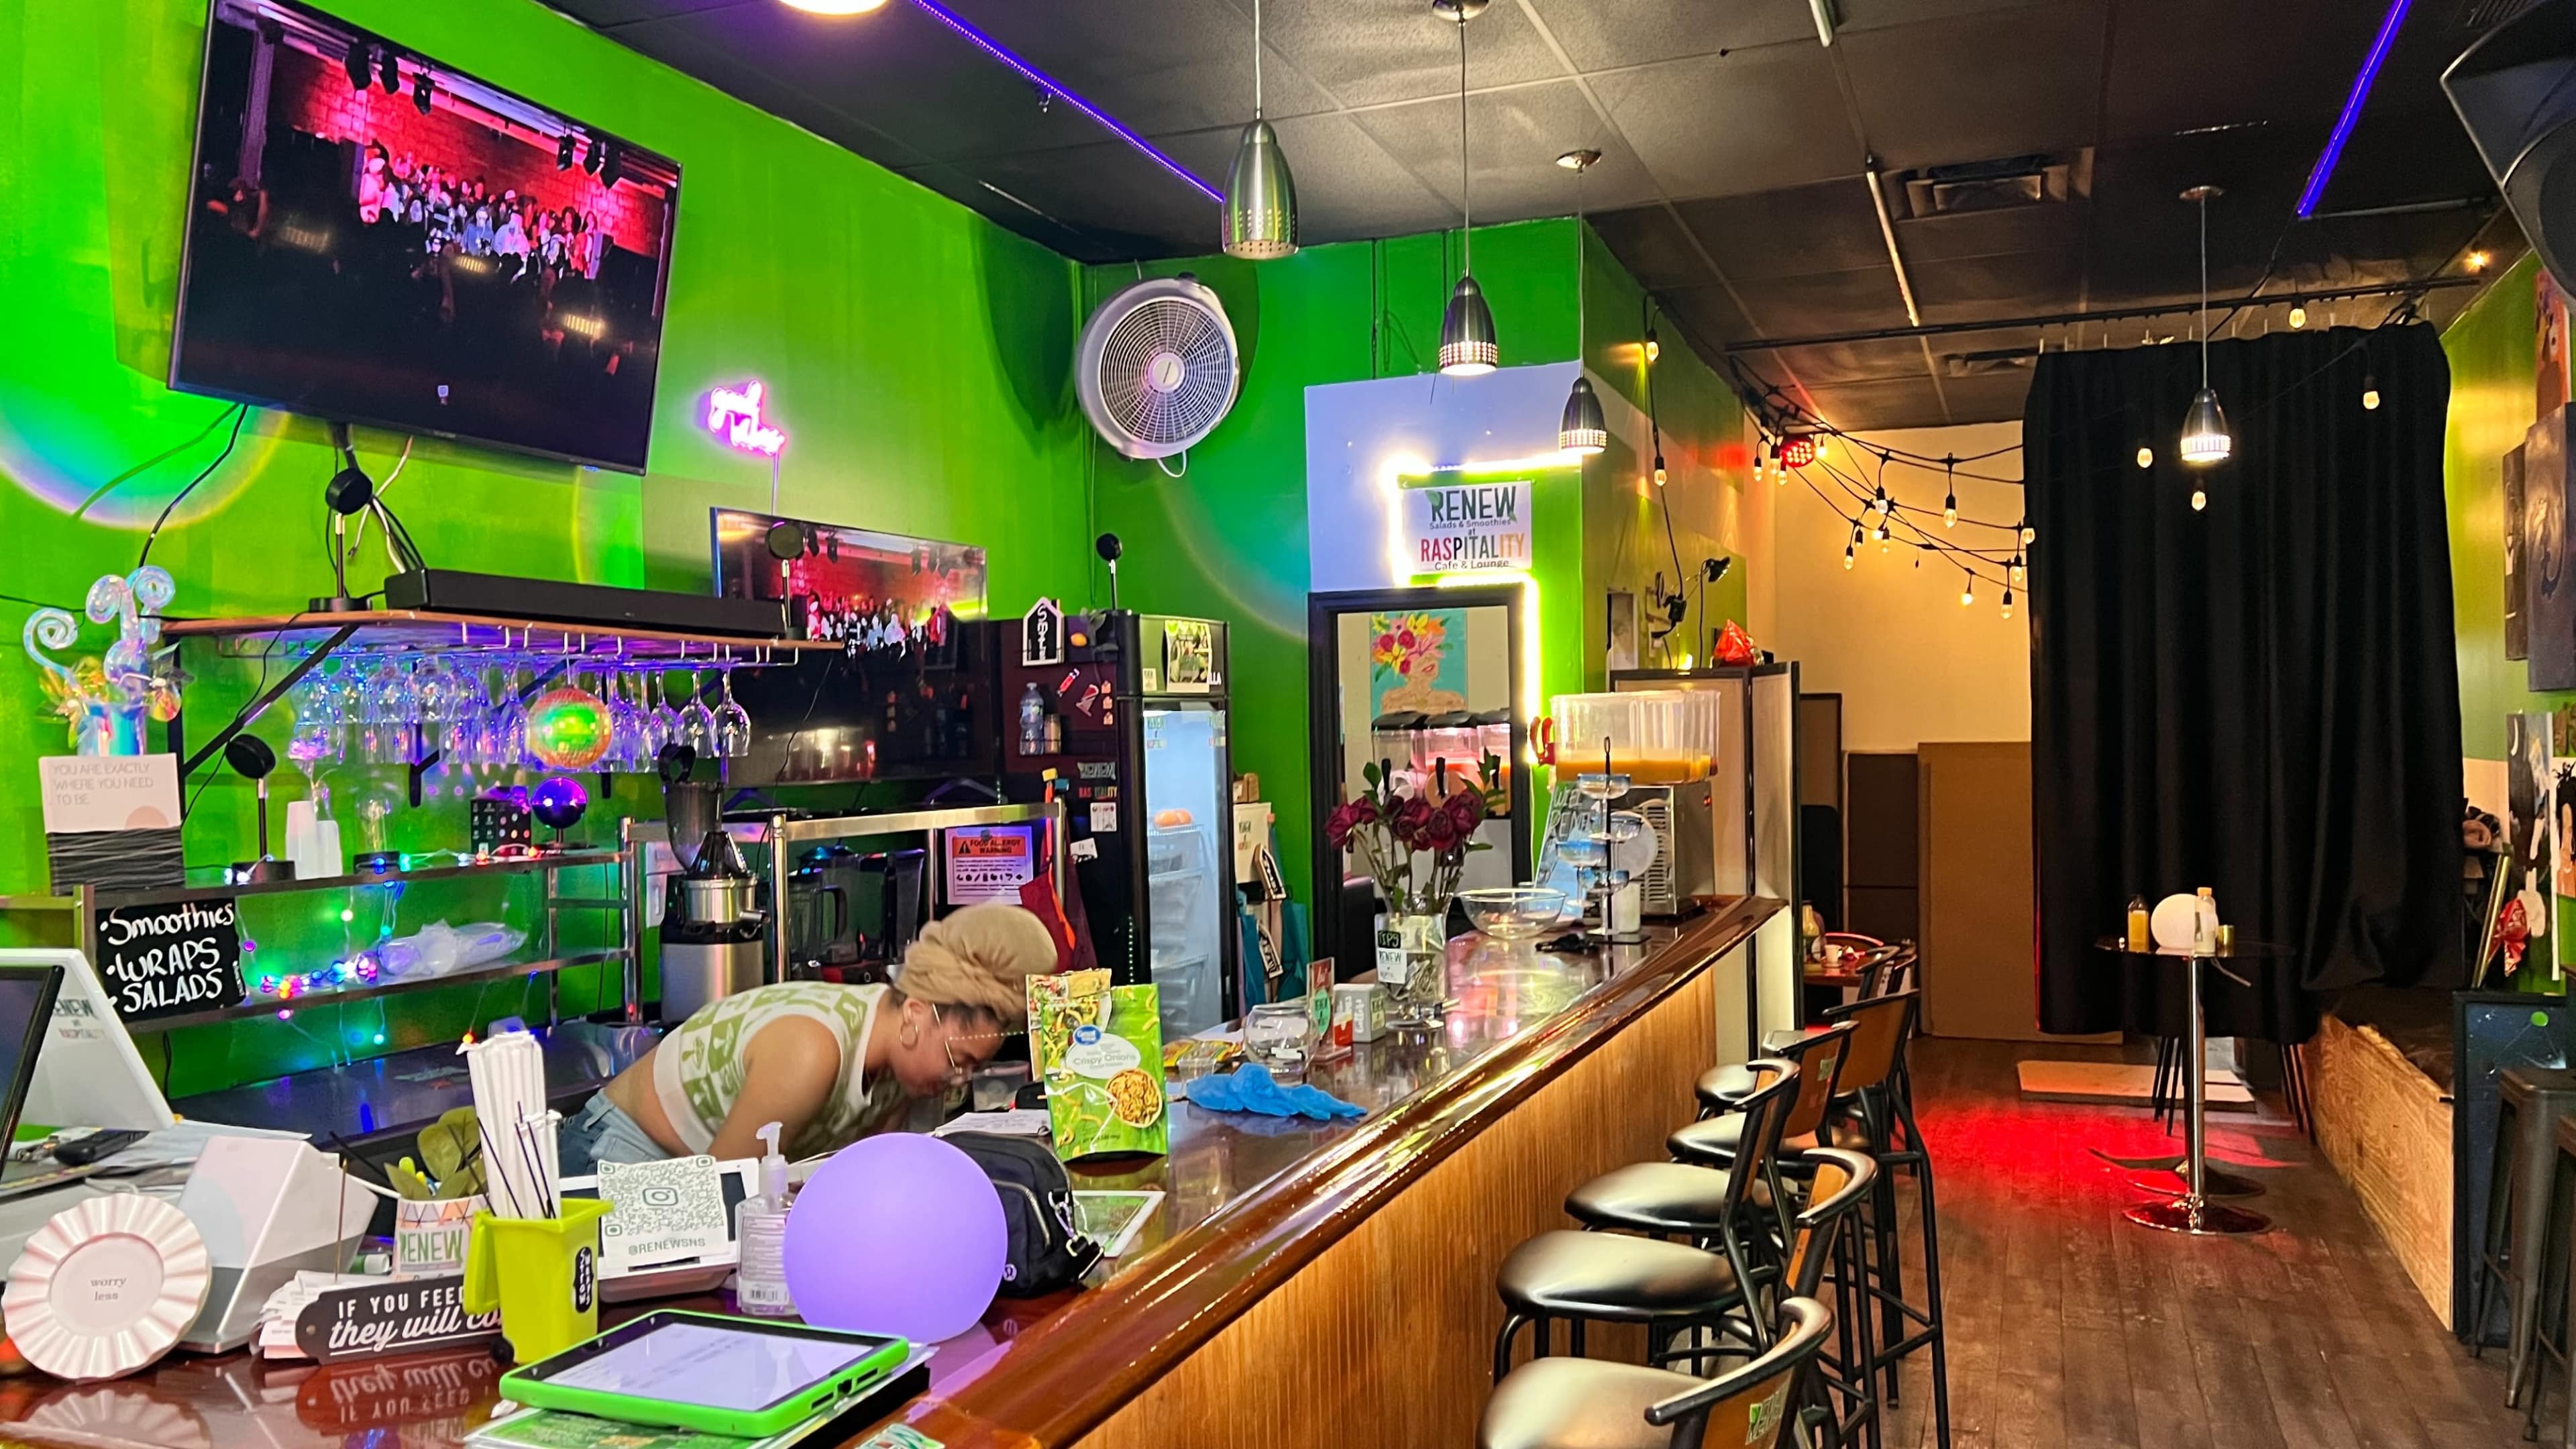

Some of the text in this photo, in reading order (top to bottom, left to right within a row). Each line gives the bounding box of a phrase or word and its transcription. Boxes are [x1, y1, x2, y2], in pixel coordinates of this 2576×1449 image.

[1429, 486, 1517, 522] RENEW
[1430, 521, 1456, 529] Salads
[1466, 519, 1511, 527] Smoothies
[1421, 533, 1525, 562] RASPITALITY
[1434, 559, 1509, 570] Cafe & Lounge
[52, 761, 150, 775] YOU ARE EXACTLY
[54, 777, 154, 790] WHERE YOU NEED
[56, 793, 89, 805] TO BE
[108, 902, 234, 946] Smoothies
[115, 937, 220, 981] WRAPS
[122, 968, 223, 1013] SALADS
[1073, 1057, 1102, 1066] Crispy
[1104, 1053, 1137, 1062] Onions
[399, 1229, 464, 1263] RENEW
[628, 1238, 706, 1256] @RENEWSNS
[91, 1277, 127, 1289] worry
[95, 1291, 118, 1301] less
[338, 1299, 356, 1320] IF
[370, 1293, 409, 1314] YOU
[329, 1320, 398, 1352] they
[402, 1305, 463, 1338] will
